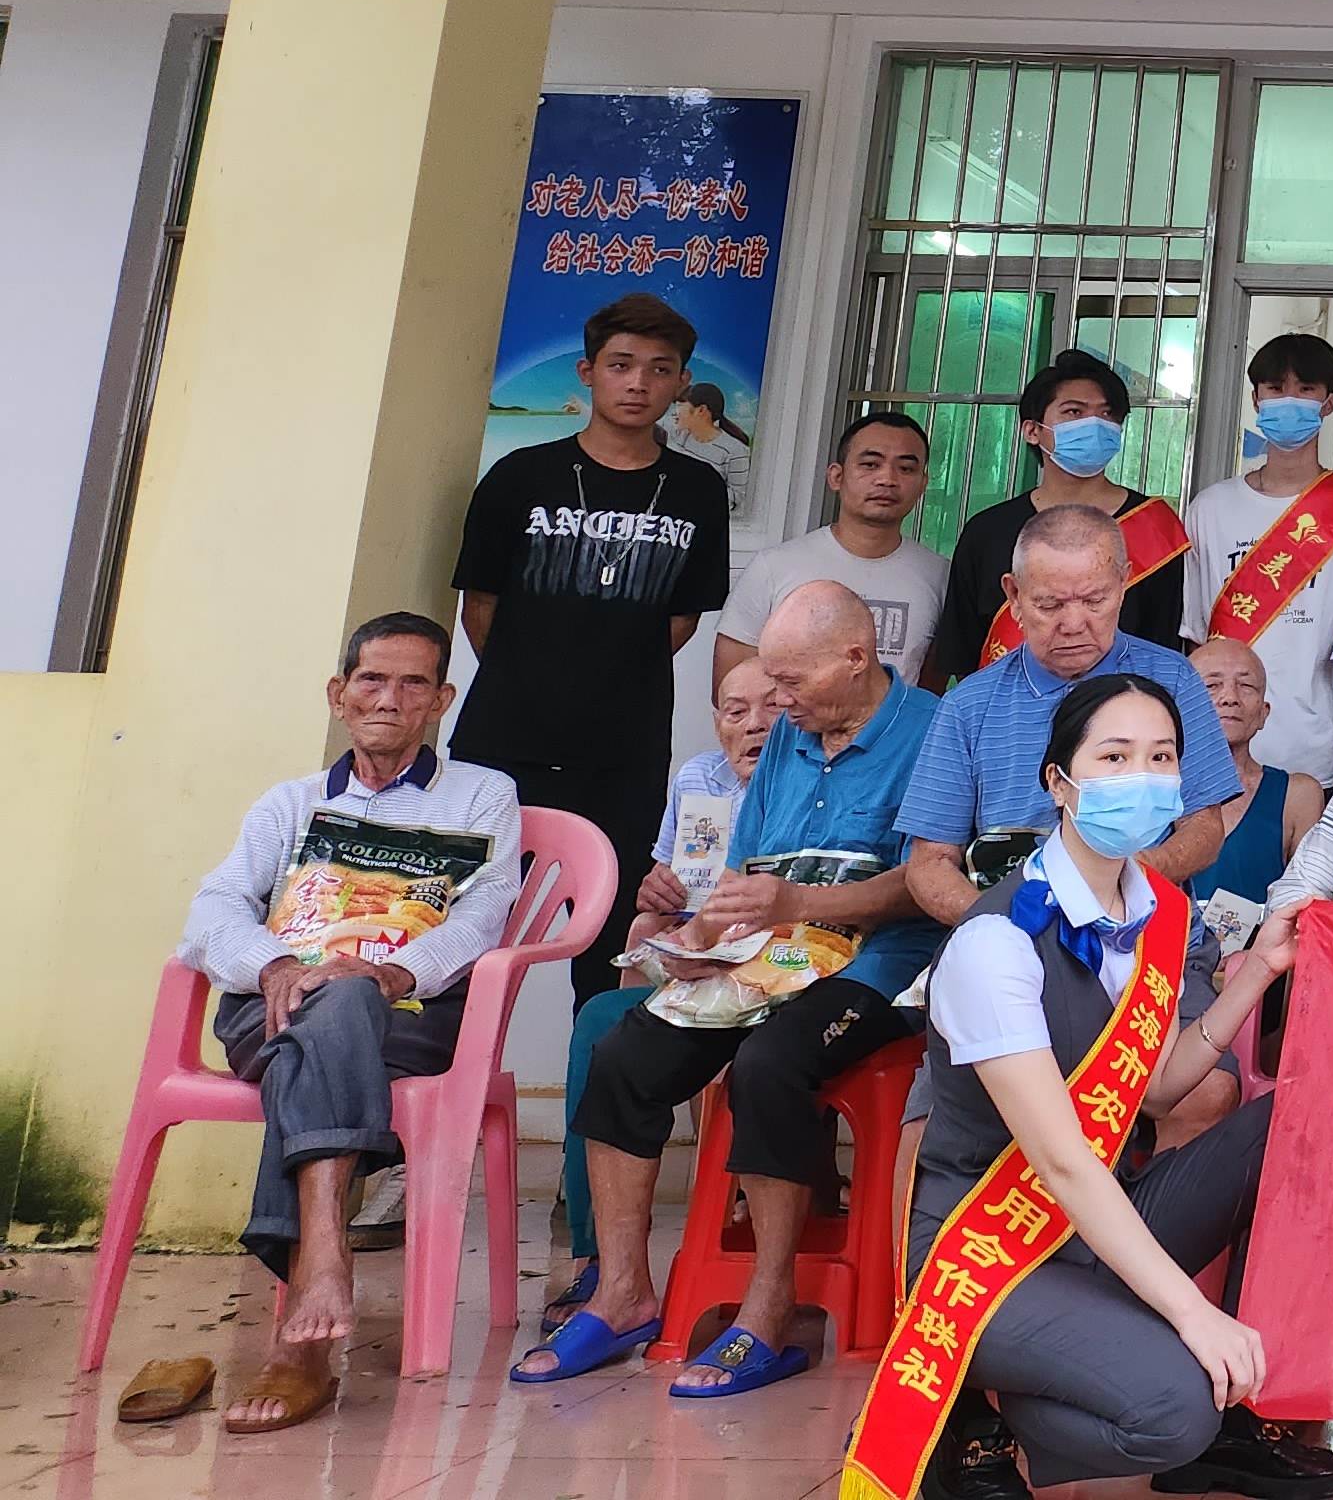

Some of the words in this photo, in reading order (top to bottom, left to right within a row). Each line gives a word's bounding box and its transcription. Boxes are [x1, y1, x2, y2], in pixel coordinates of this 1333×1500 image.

[526, 173, 750, 222] 对老人尽一份孝心
[543, 230, 770, 279] 给社会添一份和谐
[337, 840, 451, 871] GOLDROAST
[341, 853, 399, 869] NUTRITIOUS
[398, 862, 436, 877] CEREAL
[768, 943, 810, 962] 原味
[892, 962, 1175, 1403] 琼海市农用合作联社
